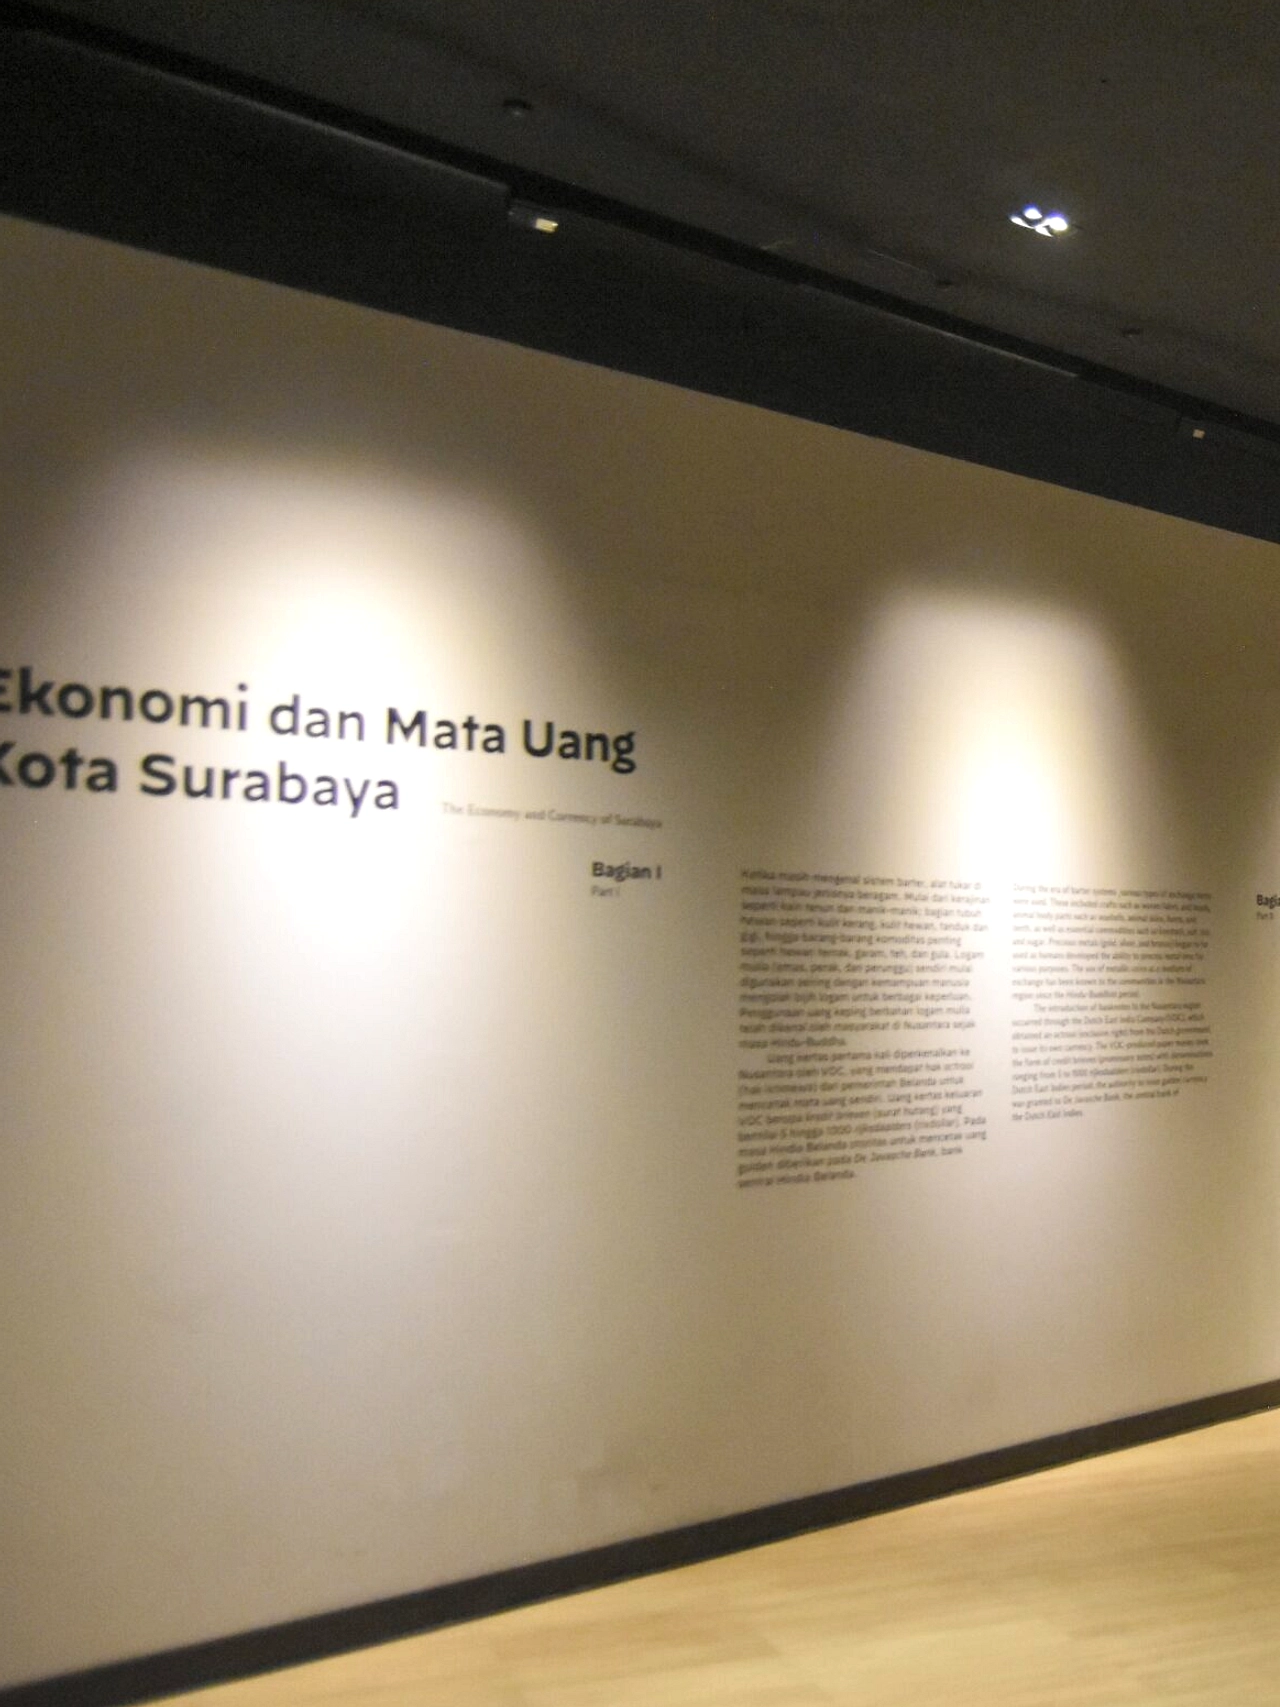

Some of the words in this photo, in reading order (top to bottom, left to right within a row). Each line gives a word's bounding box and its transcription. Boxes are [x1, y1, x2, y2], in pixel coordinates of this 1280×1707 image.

[269, 694, 366, 742] dan
[387, 706, 506, 754] Mata
[523, 718, 637, 774] Uang
[139, 752, 400, 818] Surabaya
[442, 802, 464, 815] The
[592, 860, 652, 882] Bagian
[656, 865, 662, 880] I
